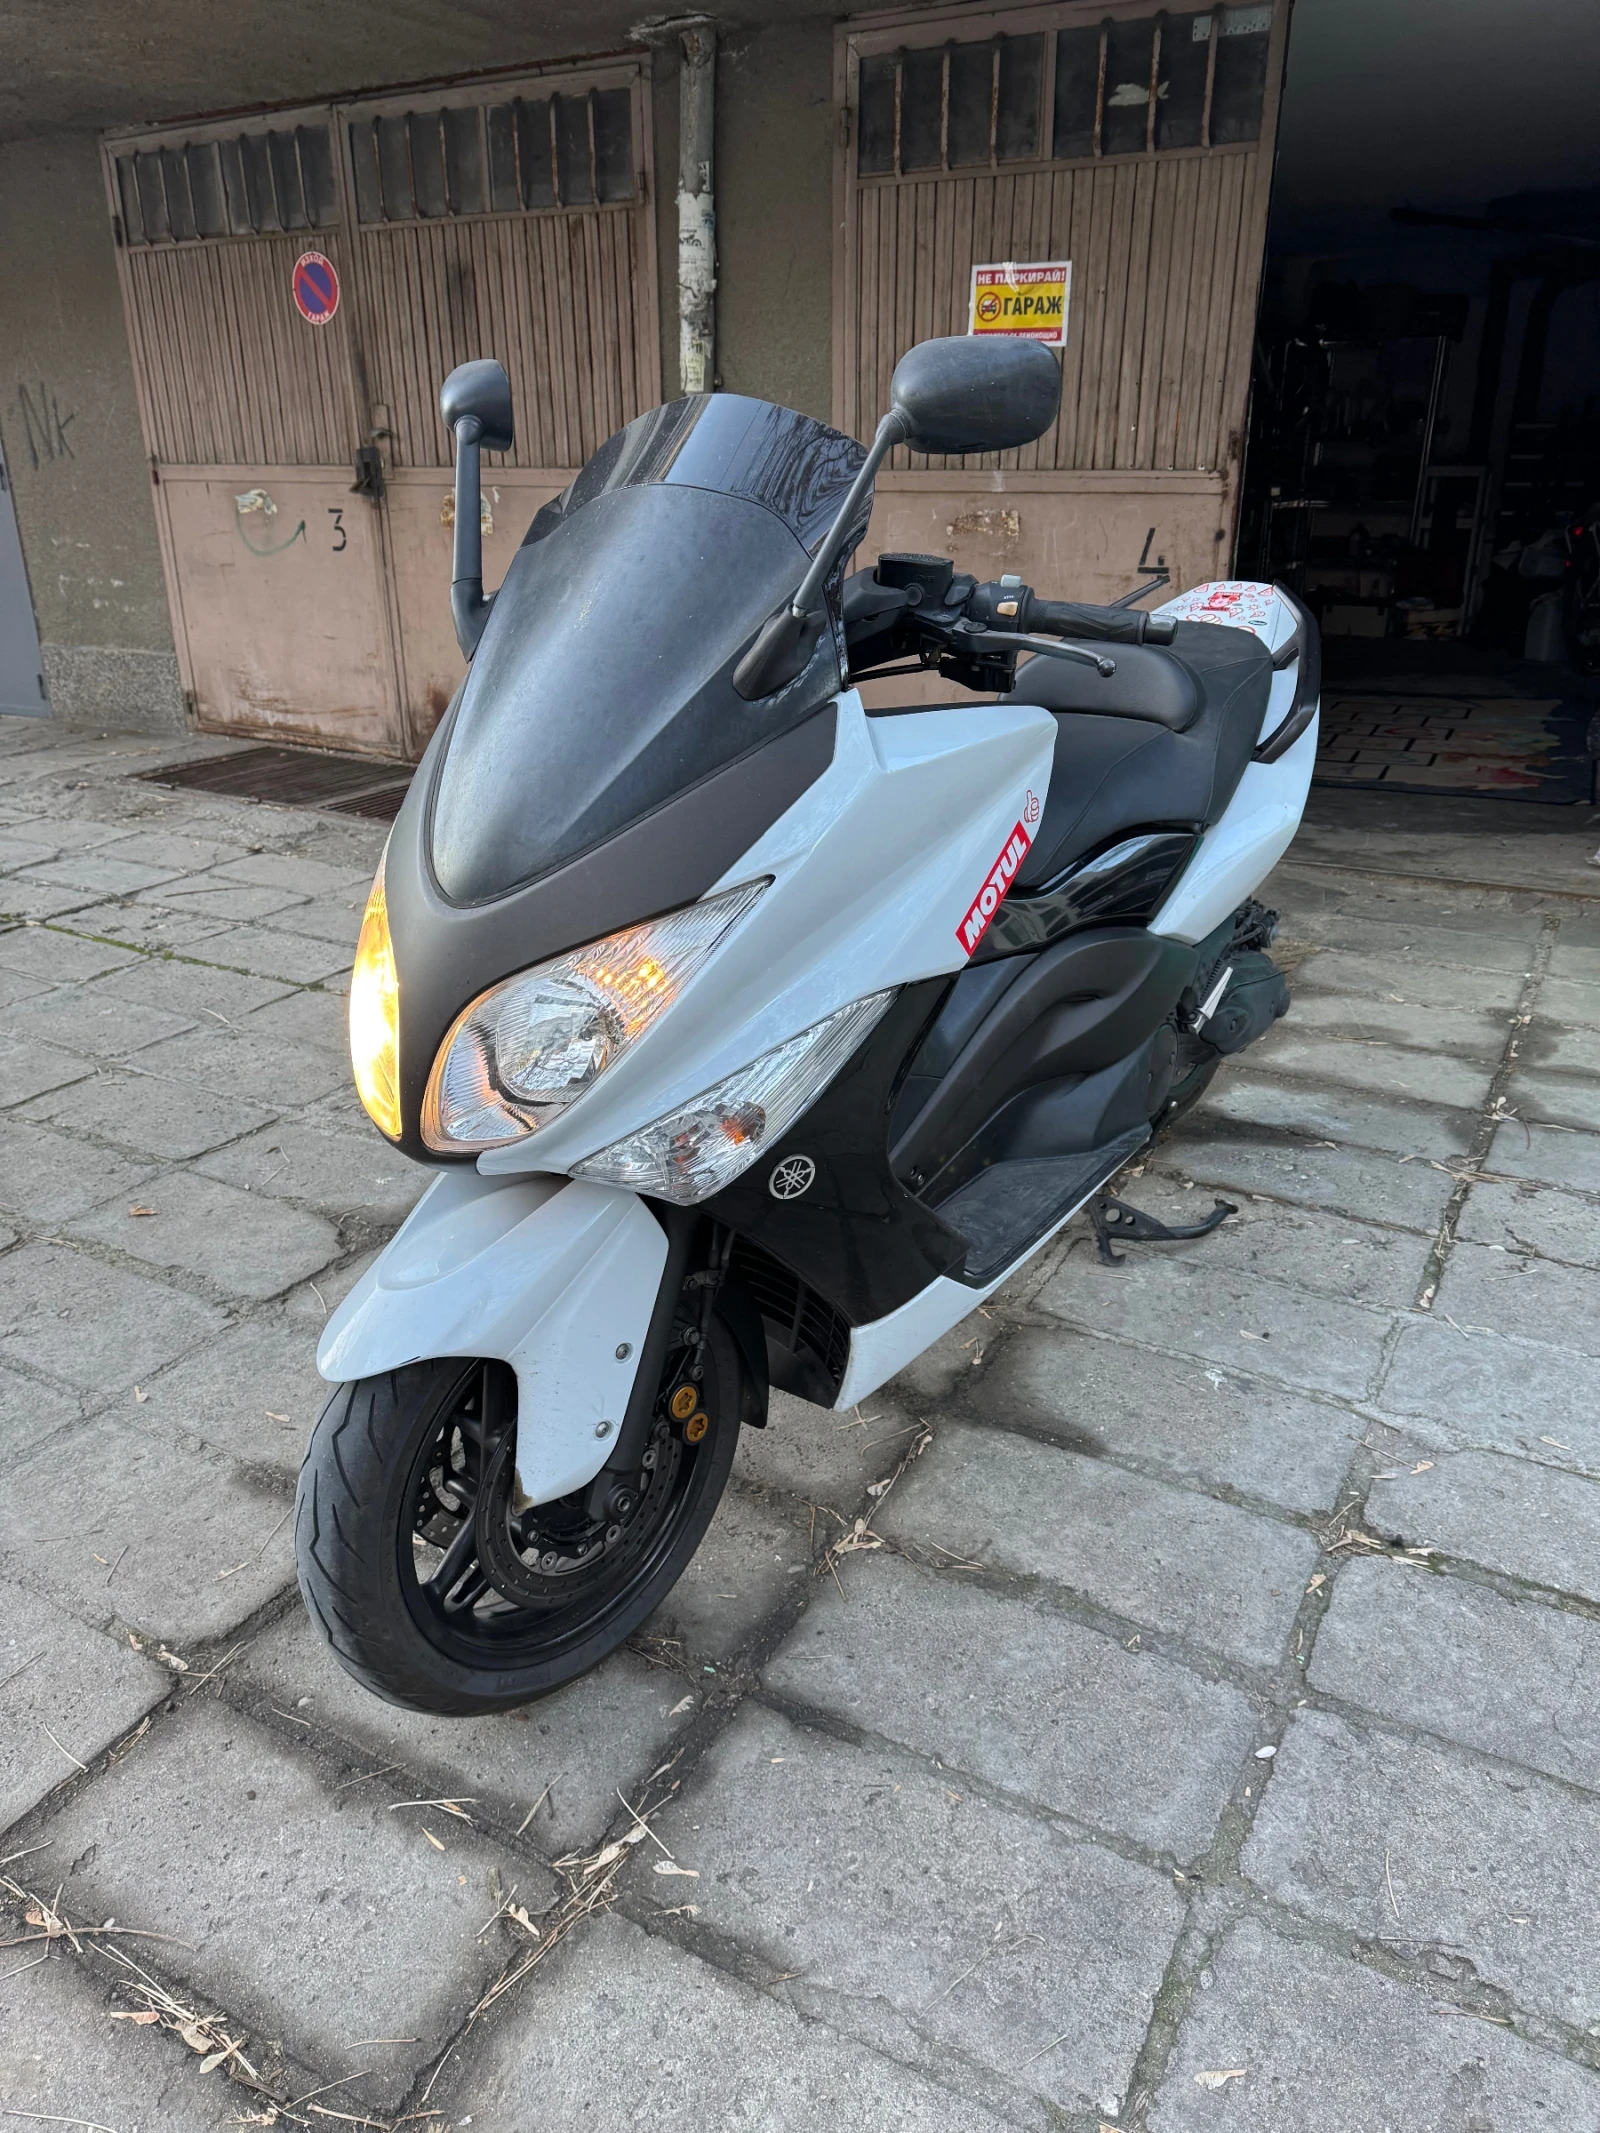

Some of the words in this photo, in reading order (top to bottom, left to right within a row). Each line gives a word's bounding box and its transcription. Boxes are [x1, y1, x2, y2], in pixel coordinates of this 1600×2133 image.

[301, 254, 324, 267] ИЗХОД
[977, 273, 992, 285] НЕ
[995, 270, 1066, 284] ПАРКИРАЙ!
[307, 309, 330, 321] ГАРАЖ
[1002, 295, 1063, 316] ГАРАЖ
[328, 508, 347, 551] 3
[1137, 527, 1170, 580] 4
[963, 833, 1027, 949] MOTUL
